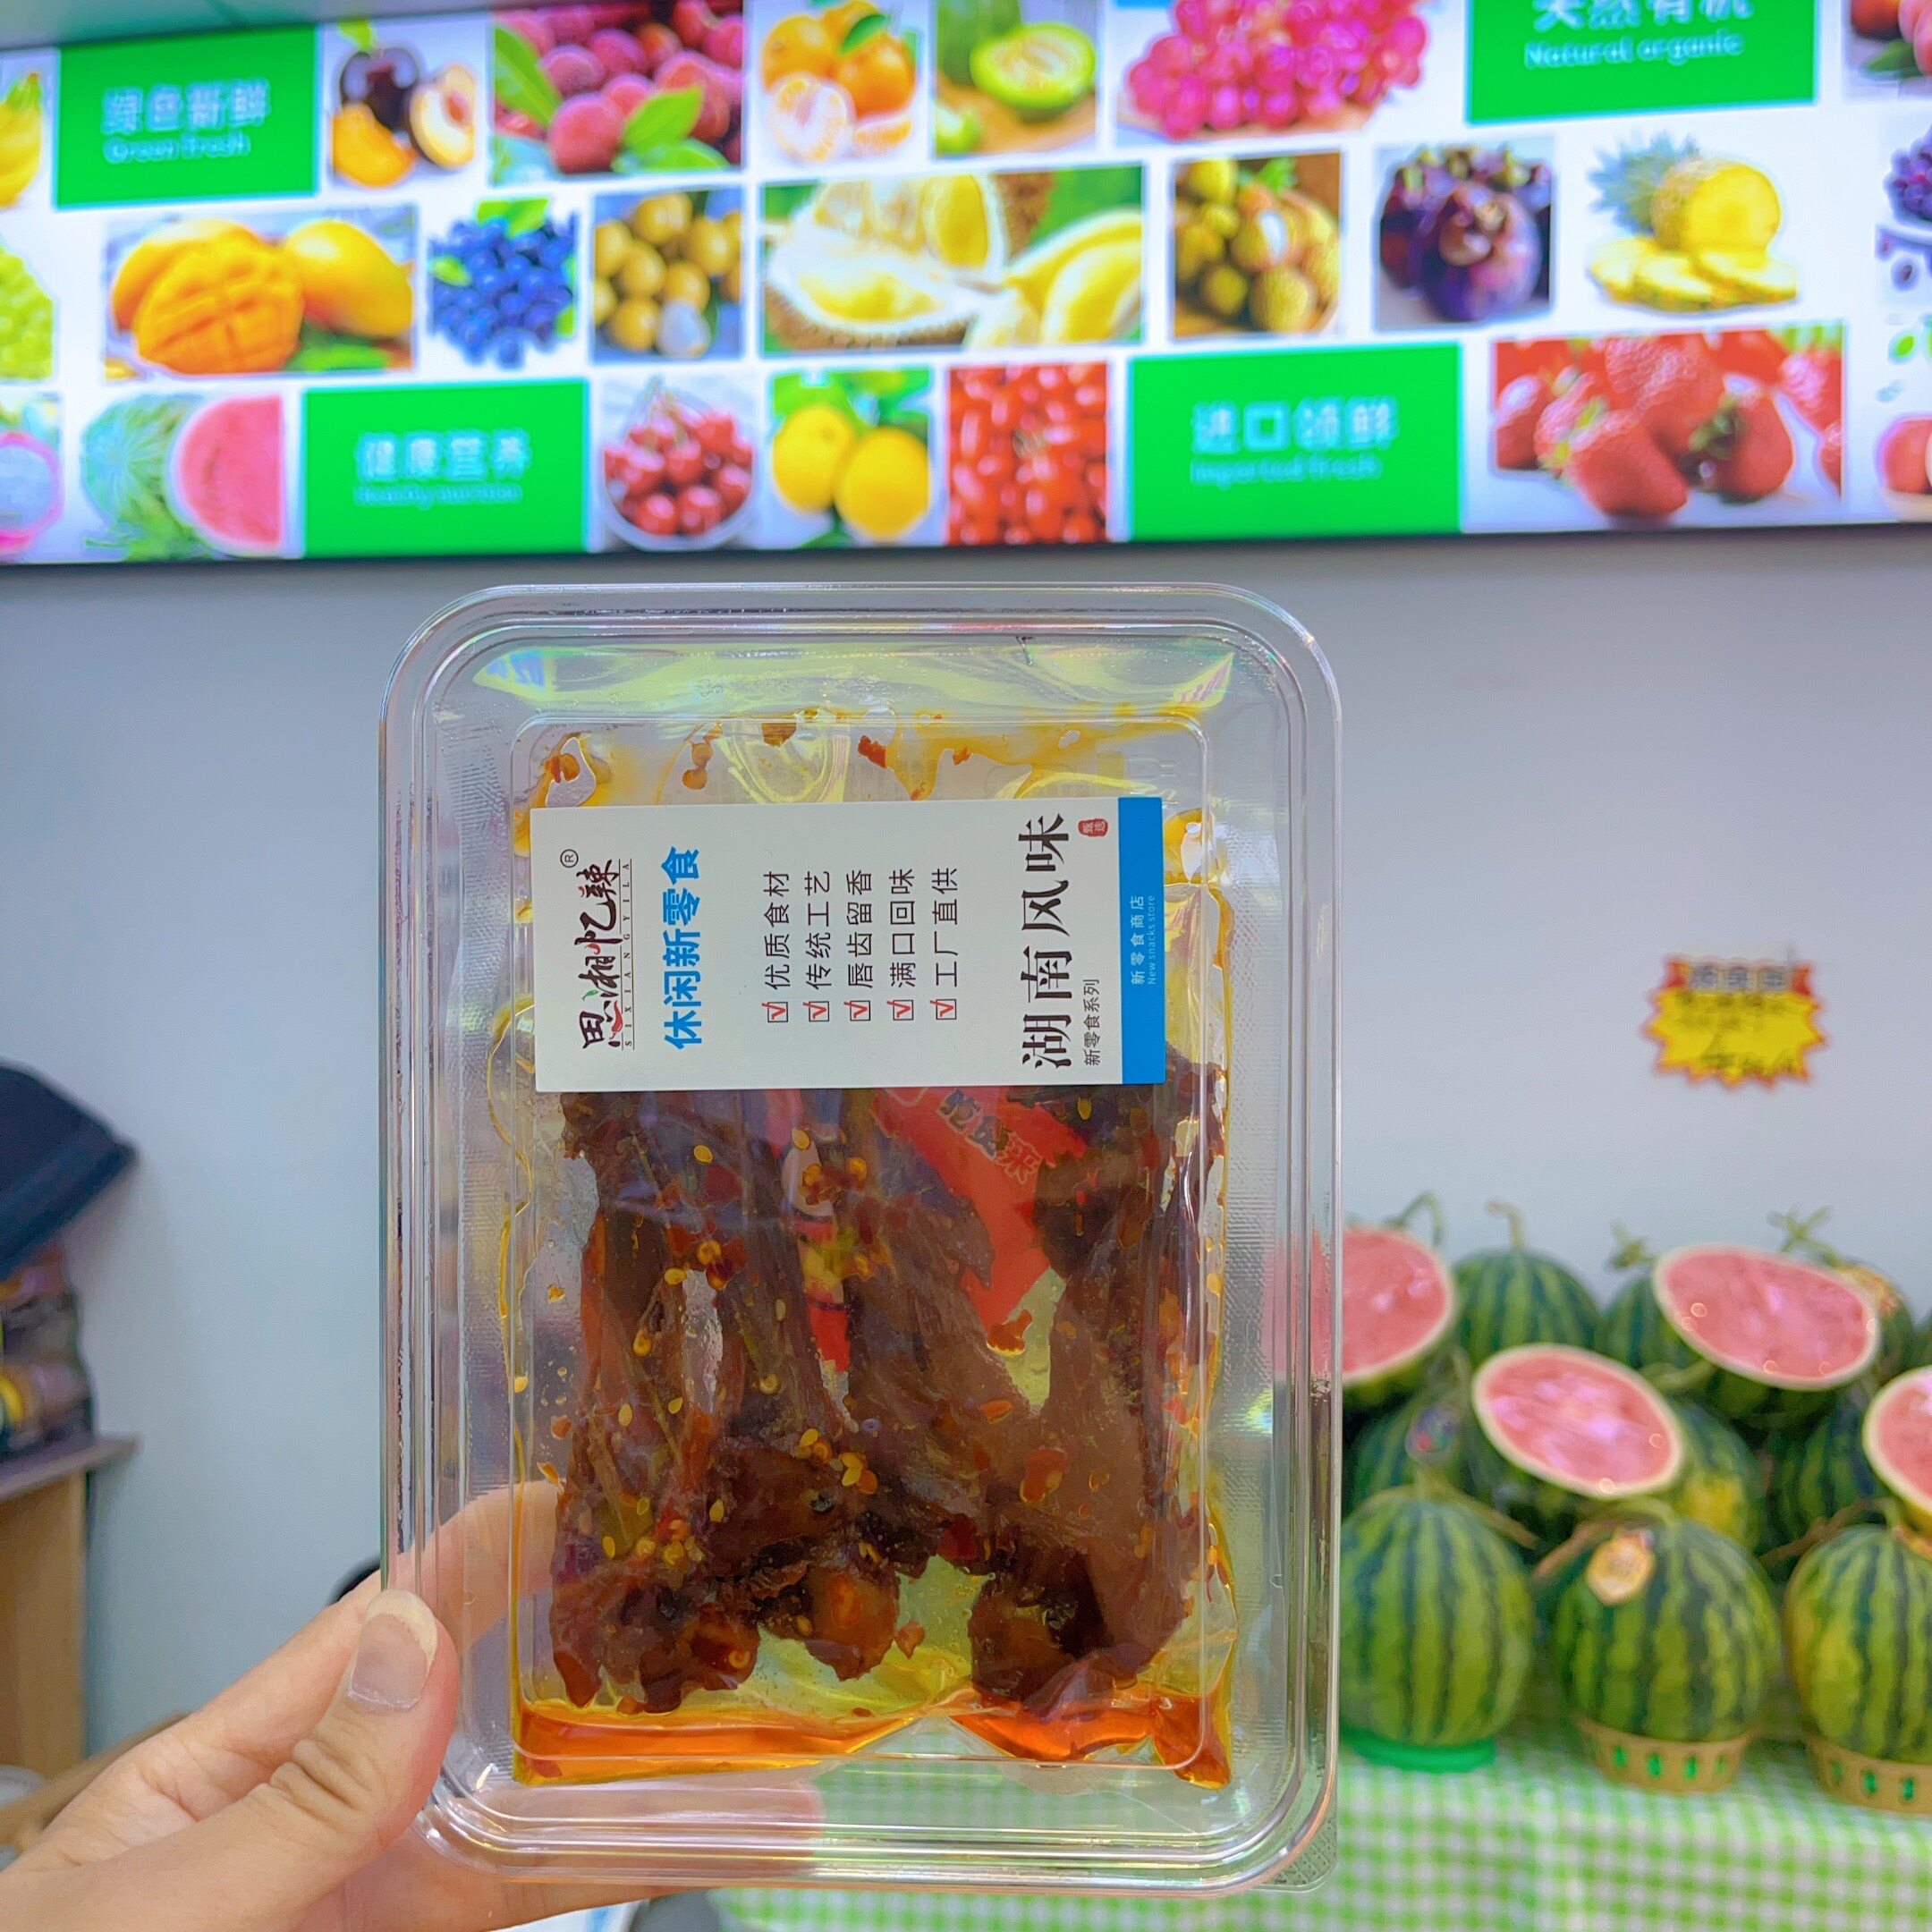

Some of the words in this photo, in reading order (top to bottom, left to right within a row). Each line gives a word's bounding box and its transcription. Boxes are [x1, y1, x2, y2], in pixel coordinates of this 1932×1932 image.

[1526, 39, 1632, 67] Natural
[1639, 30, 1743, 64] organic
[660, 845, 702, 1050] 休闲新零食
[763, 870, 791, 990] 优质食材
[804, 870, 832, 990] 传统工艺
[846, 869, 873, 988] 唇齿留香
[888, 869, 917, 988] 满口回味
[931, 868, 959, 987] 工厂直供
[1018, 813, 1072, 1070] 湖南风味
[1130, 895, 1145, 986] 新零食商店
[1147, 924, 1157, 960] snacks
[1148, 894, 1157, 922] store
[1082, 979, 1100, 1066] 新零食系列
[1147, 962, 1157, 985] New
